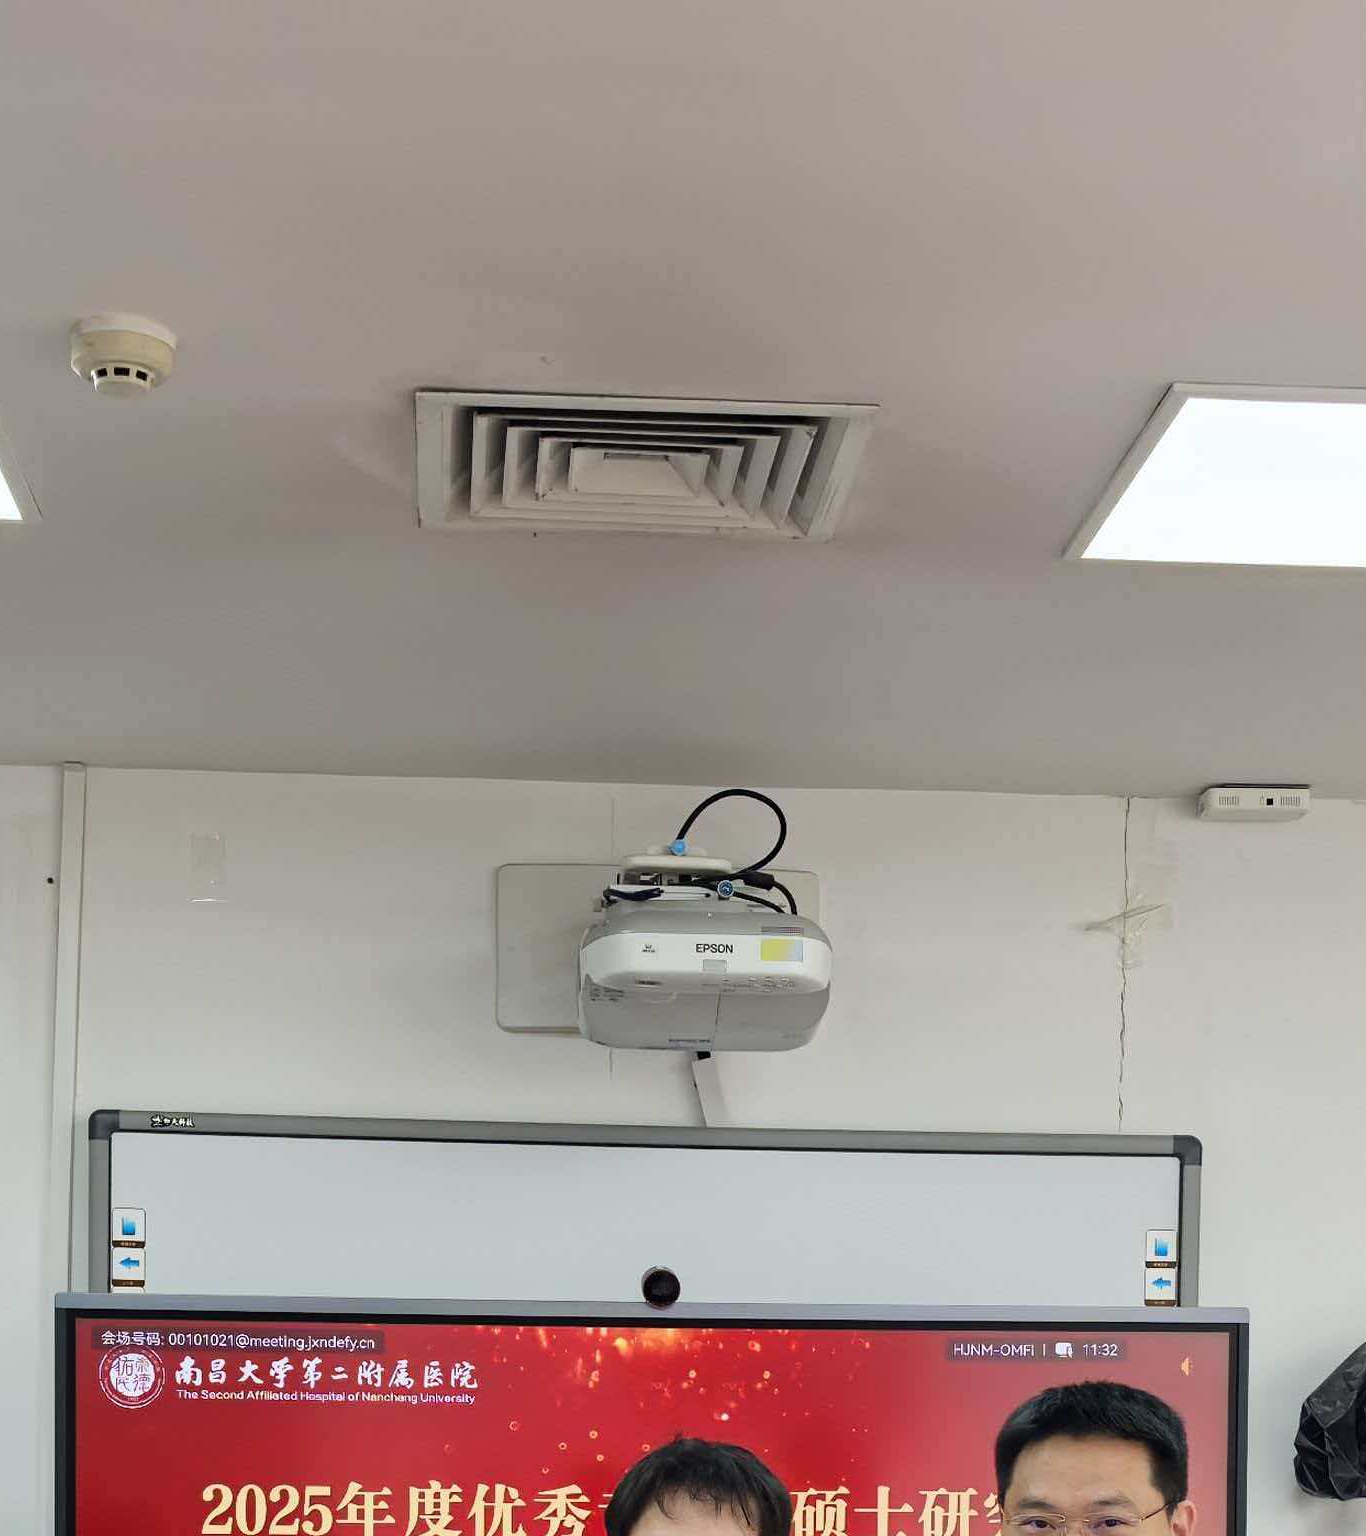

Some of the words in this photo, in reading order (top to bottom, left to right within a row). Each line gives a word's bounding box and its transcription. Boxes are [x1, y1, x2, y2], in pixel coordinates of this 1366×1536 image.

[696, 943, 733, 954] EPSON
[101, 1331, 165, 1346] 会场号码:
[168, 1333, 376, 1353] 00101021@meeting.jxndefy.cn
[1082, 1342, 1119, 1358] 11:32
[175, 1355, 479, 1389] 南昌大学第二附属医院
[176, 1390, 199, 1400] The
[202, 1390, 245, 1400] Second
[247, 1390, 298, 1401] Affiliated
[300, 1391, 346, 1403] Hospital
[348, 1391, 360, 1402] of
[362, 1392, 418, 1405] Nanchang
[420, 1393, 476, 1405] University
